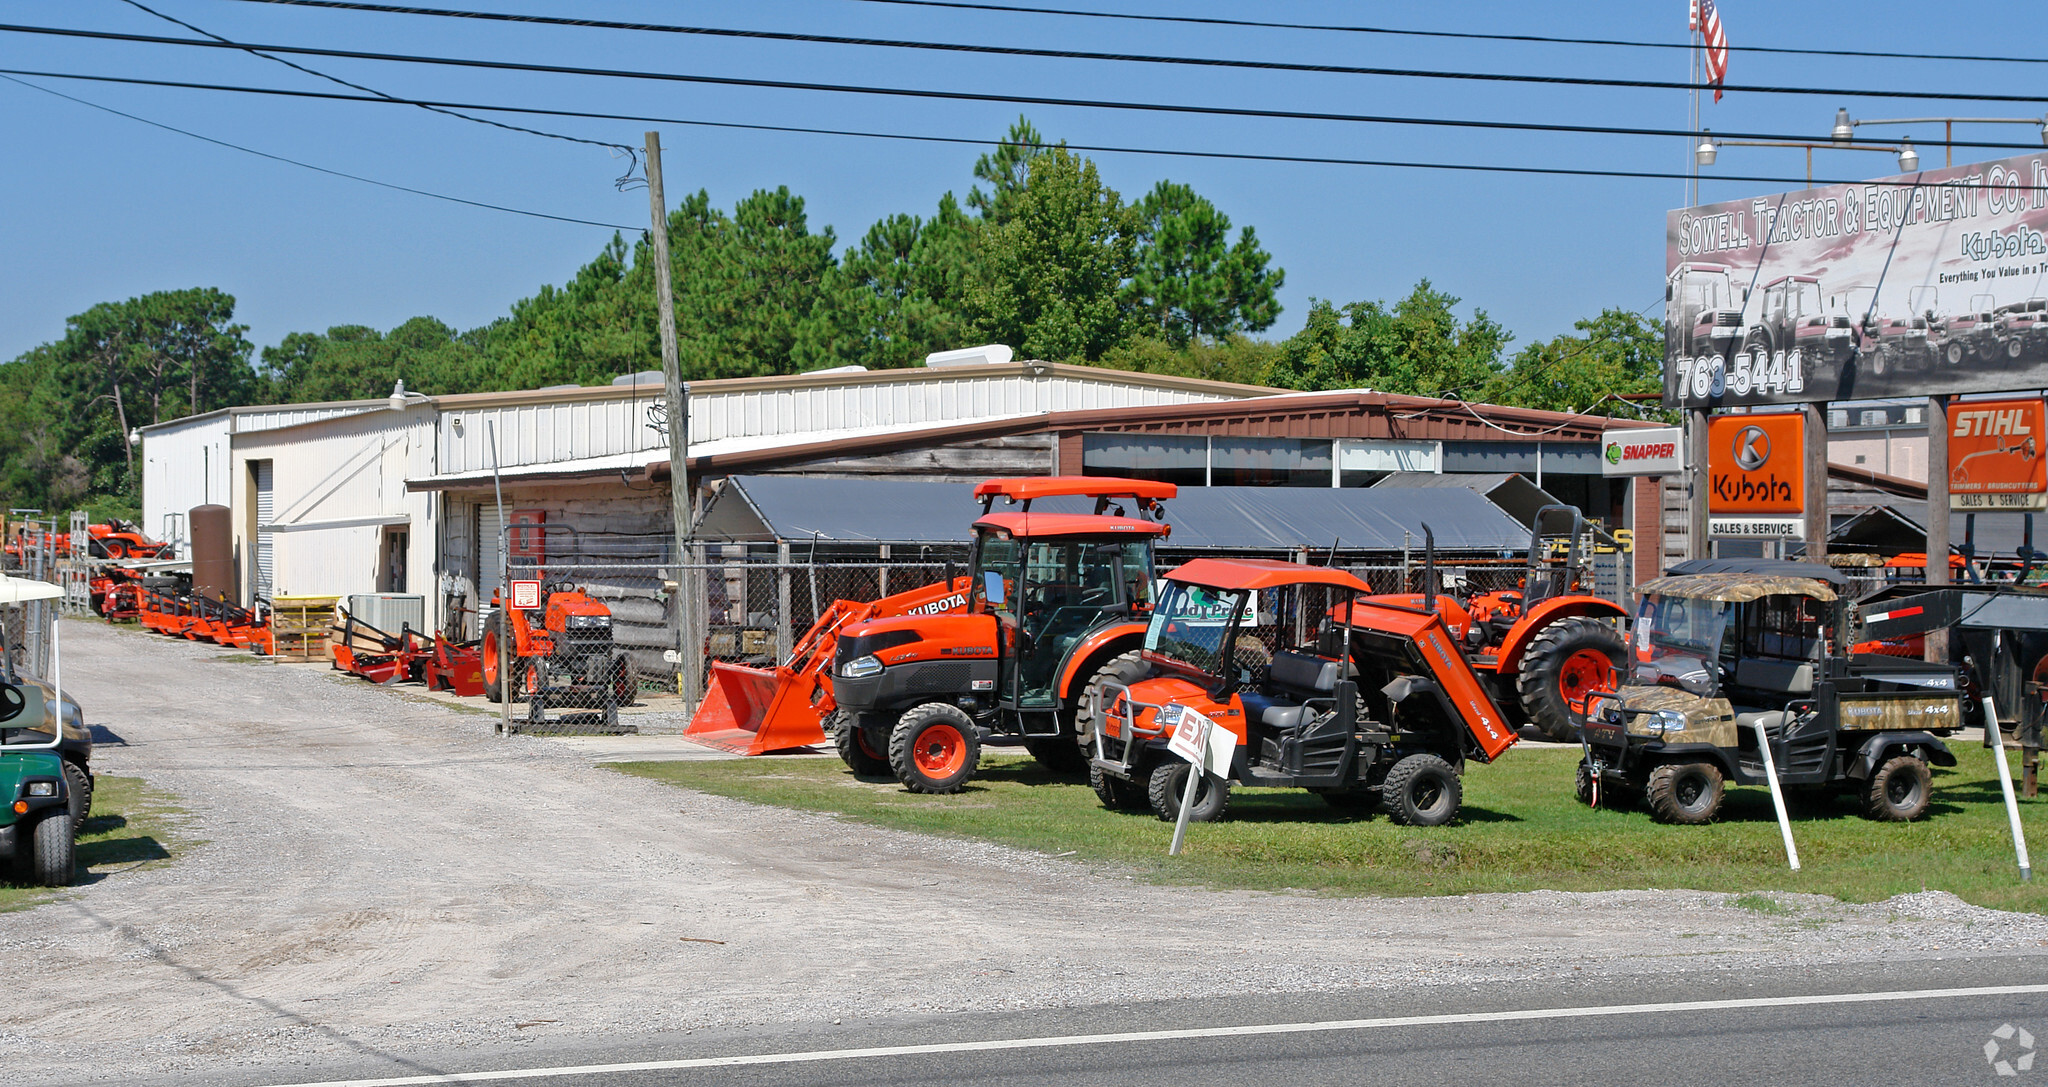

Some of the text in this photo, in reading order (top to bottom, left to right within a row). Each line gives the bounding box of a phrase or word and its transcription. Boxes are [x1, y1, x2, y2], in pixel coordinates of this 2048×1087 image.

[1679, 213, 1749, 256] SOWELL
[1753, 199, 1839, 246] TRACTOR
[1844, 187, 1859, 234] &
[1864, 174, 1983, 235] EQUIPMENT
[1987, 166, 2026, 215] CO.
[1962, 226, 2046, 261] Kubota
[1940, 271, 1979, 284] Everything
[1981, 268, 1996, 279] You
[1999, 266, 2020, 277] Value
[2022, 264, 2029, 275] in
[1677, 350, 1803, 398] 763-5441
[1953, 409, 2031, 437] STIHL
[1623, 443, 1675, 461] SNAPPER
[1713, 473, 1792, 502] Kubota
[1950, 482, 1982, 490] TRIMMERS
[1987, 482, 2039, 490] BRUSHCUTTERS
[1960, 493, 2030, 507] SALES & SERVICE
[1712, 523, 1794, 535] SALES & SERVICE
[907, 593, 967, 616] KUBOTA
[952, 646, 994, 656] KUBOTA
[1924, 705, 1950, 714] 4x4
